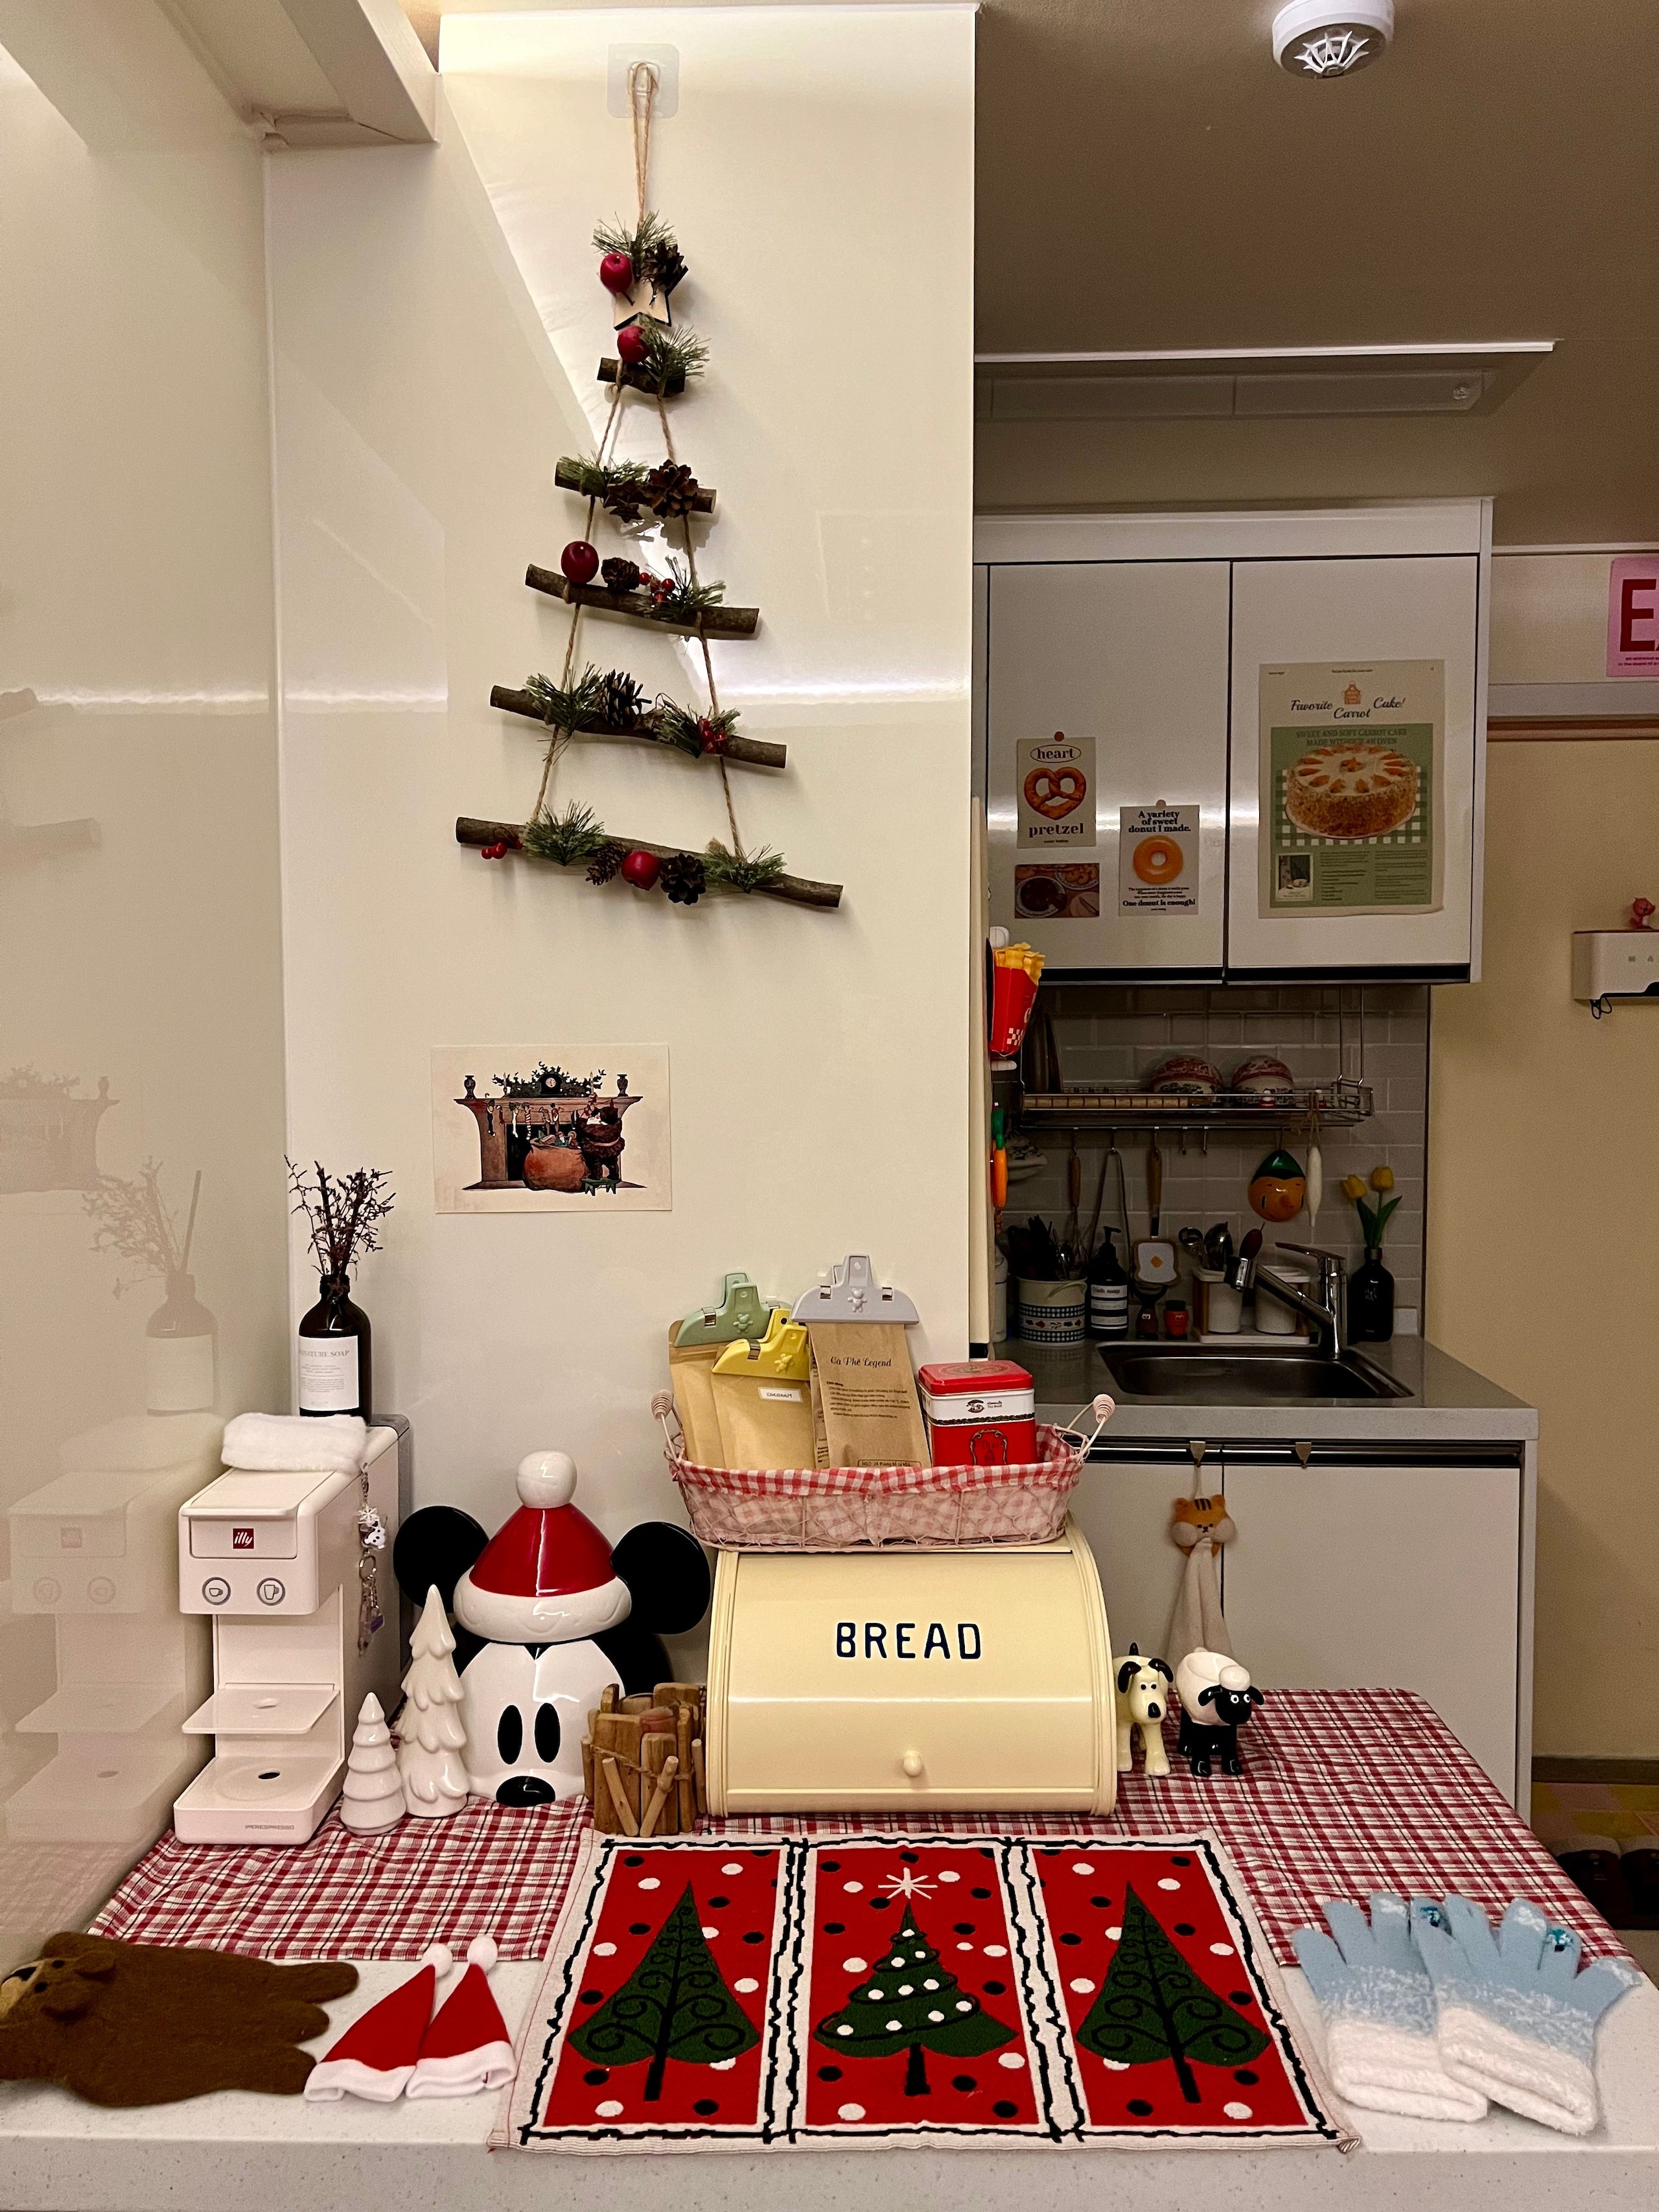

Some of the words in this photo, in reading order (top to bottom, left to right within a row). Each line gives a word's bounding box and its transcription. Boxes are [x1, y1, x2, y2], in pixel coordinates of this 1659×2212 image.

[1620, 578, 1659, 652] E
[1291, 699, 1334, 711] Favorite
[1373, 697, 1406, 709] Cake!
[1334, 707, 1371, 719] Carrot
[1296, 730, 1321, 738] SWEET
[1322, 729, 1338, 738] AND
[1339, 728, 1357, 737] SOFT
[1358, 728, 1386, 737] CARROT
[1387, 728, 1407, 736] CAKE
[1037, 747, 1075, 759] heart
[1029, 822, 1084, 838] pretzel
[1167, 898, 1195, 907] enough!
[863, 1357, 892, 1368] Legend
[234, 1531, 253, 1548] illy
[837, 1622, 981, 1659] BREAD
